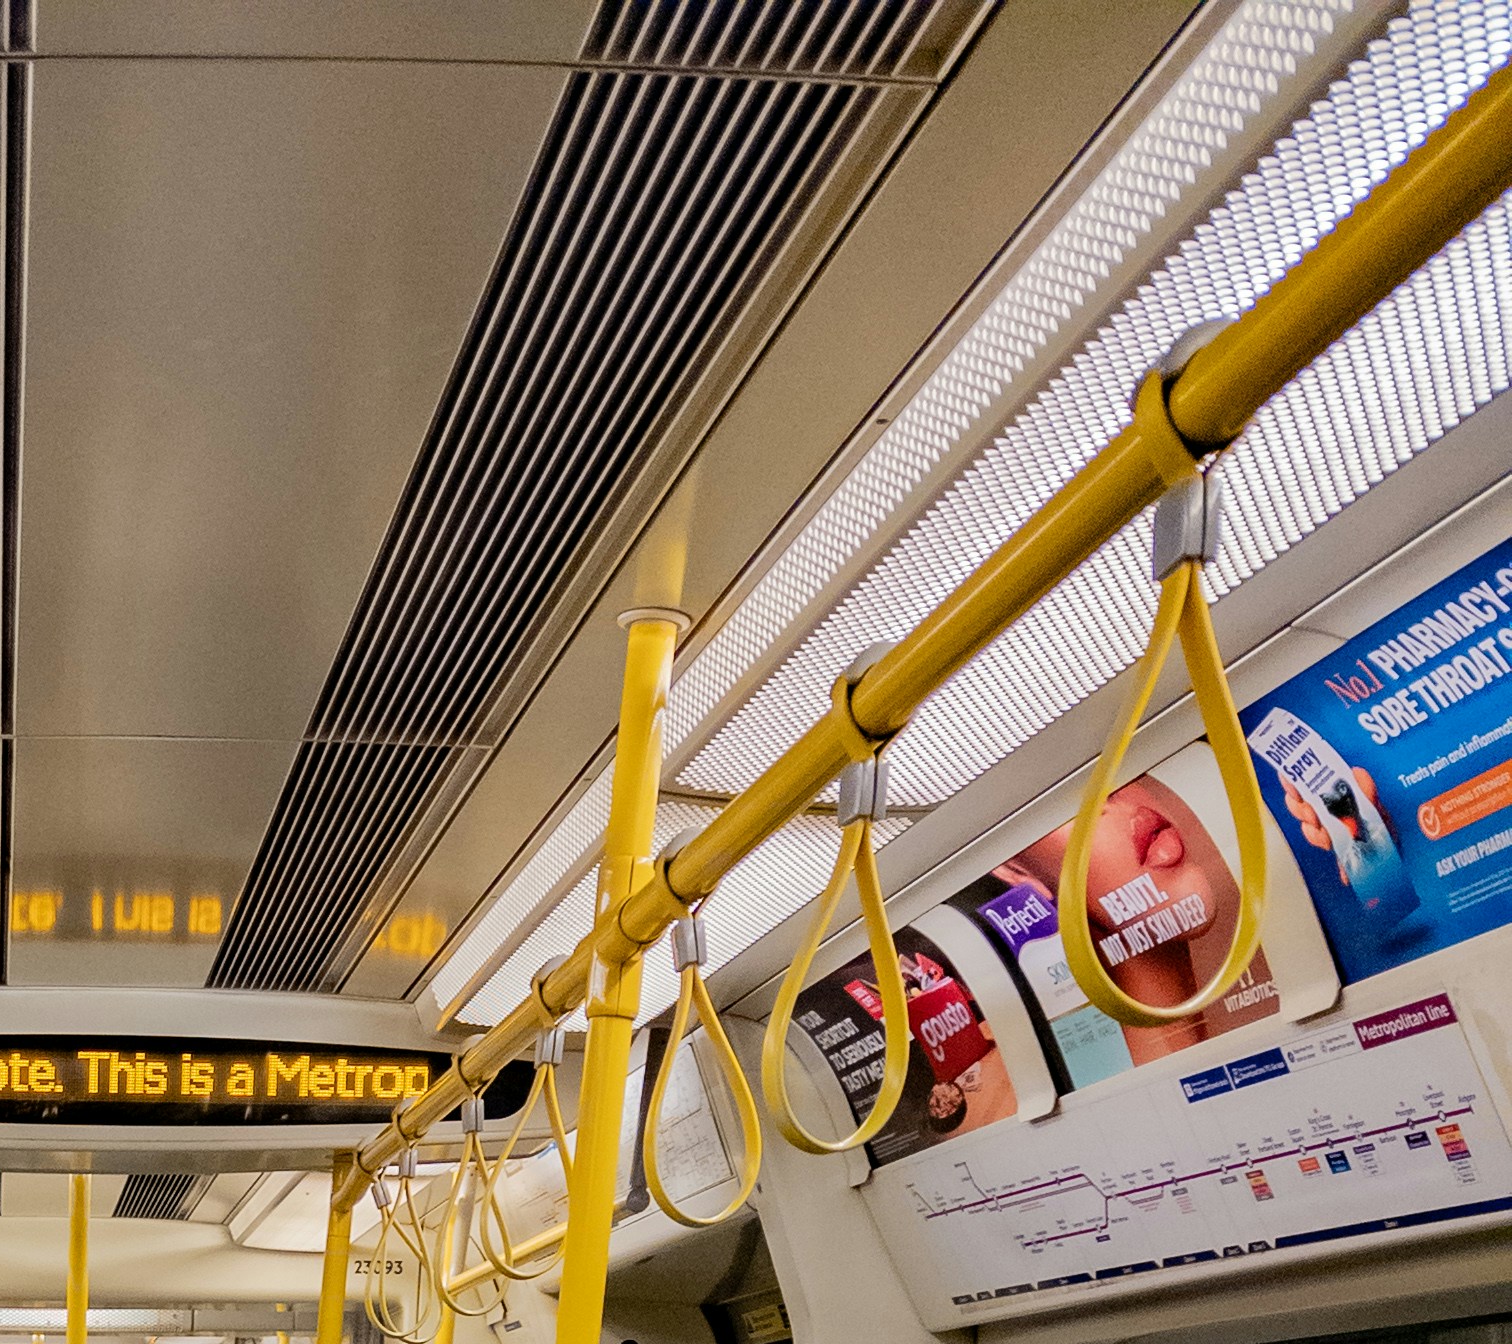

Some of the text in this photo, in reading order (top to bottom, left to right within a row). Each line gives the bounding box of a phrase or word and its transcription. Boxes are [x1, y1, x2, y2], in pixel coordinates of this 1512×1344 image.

[1324, 659, 1384, 709] No.1
[1357, 637, 1511, 745] SORE THROAT
[1265, 724, 1310, 766] Difflam
[1283, 748, 1323, 783] Spray
[1397, 766, 1430, 788] Treats
[1429, 756, 1449, 777] pain
[1447, 743, 1467, 763] and
[1436, 856, 1457, 878] ASK
[1453, 844, 1478, 869] YOUR
[985, 894, 1052, 946] Perfectil
[1098, 872, 1169, 926] BEAUTY.
[1099, 893, 1207, 967] NOT JUST SKIN DEEP
[1224, 980, 1280, 1013] VITABIOTICS
[815, 1017, 859, 1050] SHORTCUT
[921, 1002, 971, 1062] gousto
[1359, 1003, 1450, 1043] Metropolitan line
[829, 1030, 886, 1071] TO SERIOUSLY
[78, 1051, 168, 1095] This
[182, 1053, 215, 1095] is
[226, 1060, 255, 1097] a
[841, 1067, 871, 1093] TASTY
